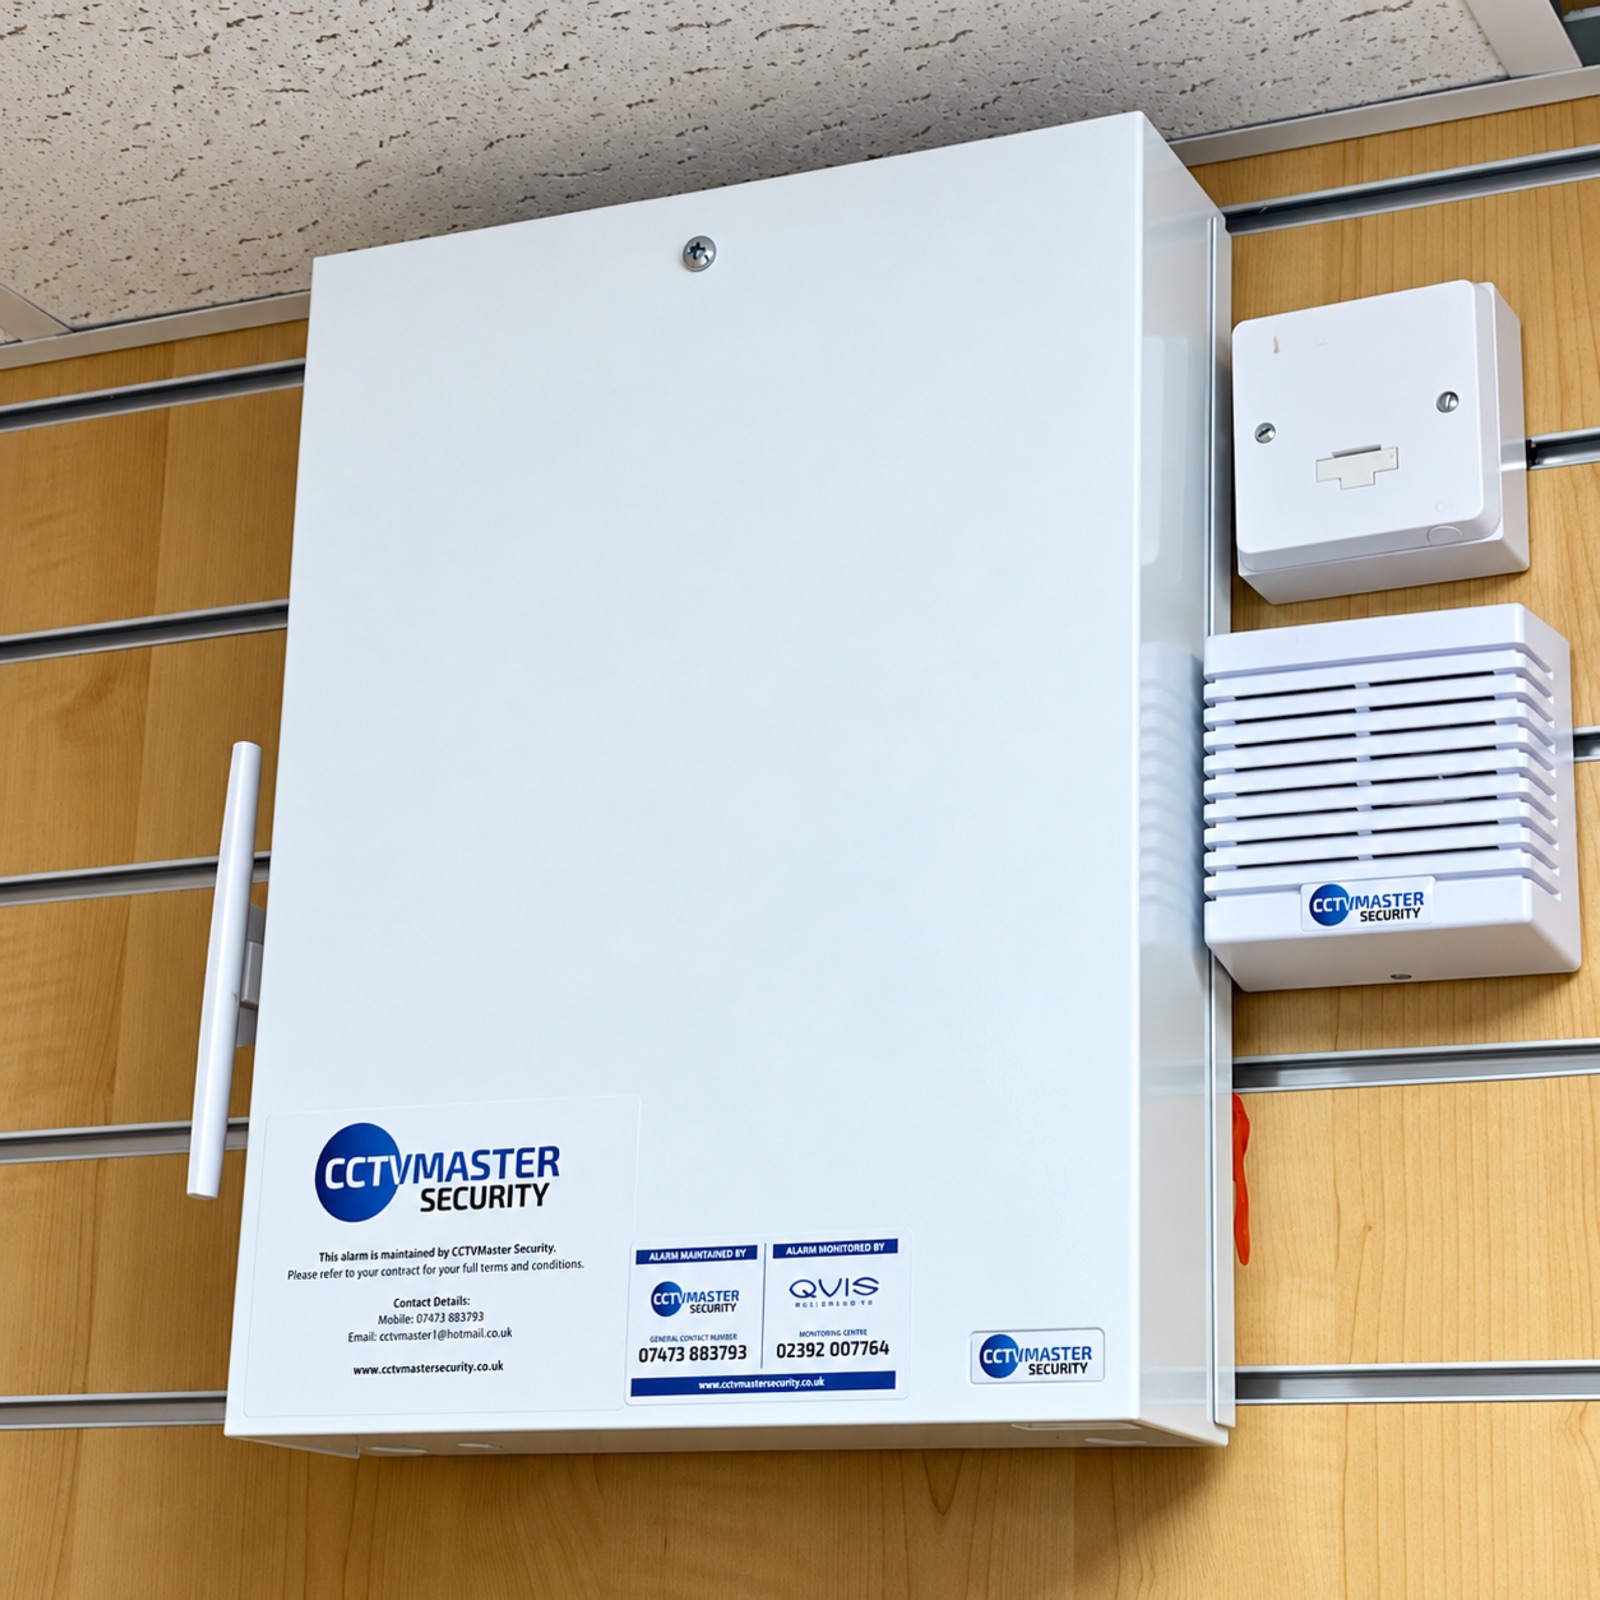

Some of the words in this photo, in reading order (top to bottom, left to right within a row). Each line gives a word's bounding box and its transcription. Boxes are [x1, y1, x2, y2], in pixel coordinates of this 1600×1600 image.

[1313, 891, 1424, 913] CCTVMASTER
[1360, 907, 1421, 922] SECURITY
[324, 1145, 560, 1190] CCTVMASTER
[420, 1182, 550, 1212] SECURITY
[319, 1252, 339, 1262] This
[340, 1251, 369, 1262] alarm
[370, 1250, 379, 1260] is
[380, 1247, 436, 1260] maintained
[437, 1247, 450, 1259] by
[451, 1245, 512, 1257] CCTVMaster
[513, 1242, 556, 1255] Security.
[648, 1251, 679, 1261] ALARM
[735, 1248, 747, 1258] BY
[784, 1246, 817, 1255] ALARM
[873, 1242, 885, 1252] BY
[287, 1270, 318, 1280] Please
[319, 1268, 343, 1279] refer
[345, 1269, 355, 1278] to
[356, 1268, 379, 1280] your
[380, 1265, 420, 1277] contract
[422, 1264, 437, 1275] for
[438, 1265, 461, 1277] your
[462, 1262, 479, 1274] full
[480, 1262, 509, 1273] terms
[510, 1260, 530, 1271] and
[531, 1259, 585, 1271] conditions.
[788, 1276, 880, 1299] QVIS
[393, 1298, 431, 1309] Contact
[433, 1296, 471, 1307] Details:
[653, 1290, 740, 1305] CCTVMASTER
[689, 1302, 737, 1314] SECURITY
[378, 1314, 414, 1325] Mobile:
[416, 1313, 446, 1324] 07473
[448, 1311, 485, 1323] 883793
[348, 1331, 377, 1343] Email:
[379, 1327, 513, 1342] cctvmaster1@hotmail.co.uk
[638, 1347, 685, 1363] 07473
[689, 1344, 748, 1362] 883793
[776, 1342, 825, 1359] 02392
[829, 1340, 890, 1357] 007764
[983, 1346, 1093, 1364] CCTVMASTER
[353, 1360, 504, 1375] www.cctvmastersecurity.co.uk
[1028, 1362, 1089, 1376] SECURITY
[698, 1376, 825, 1390] www.cctvmastersecurity.co.uk
